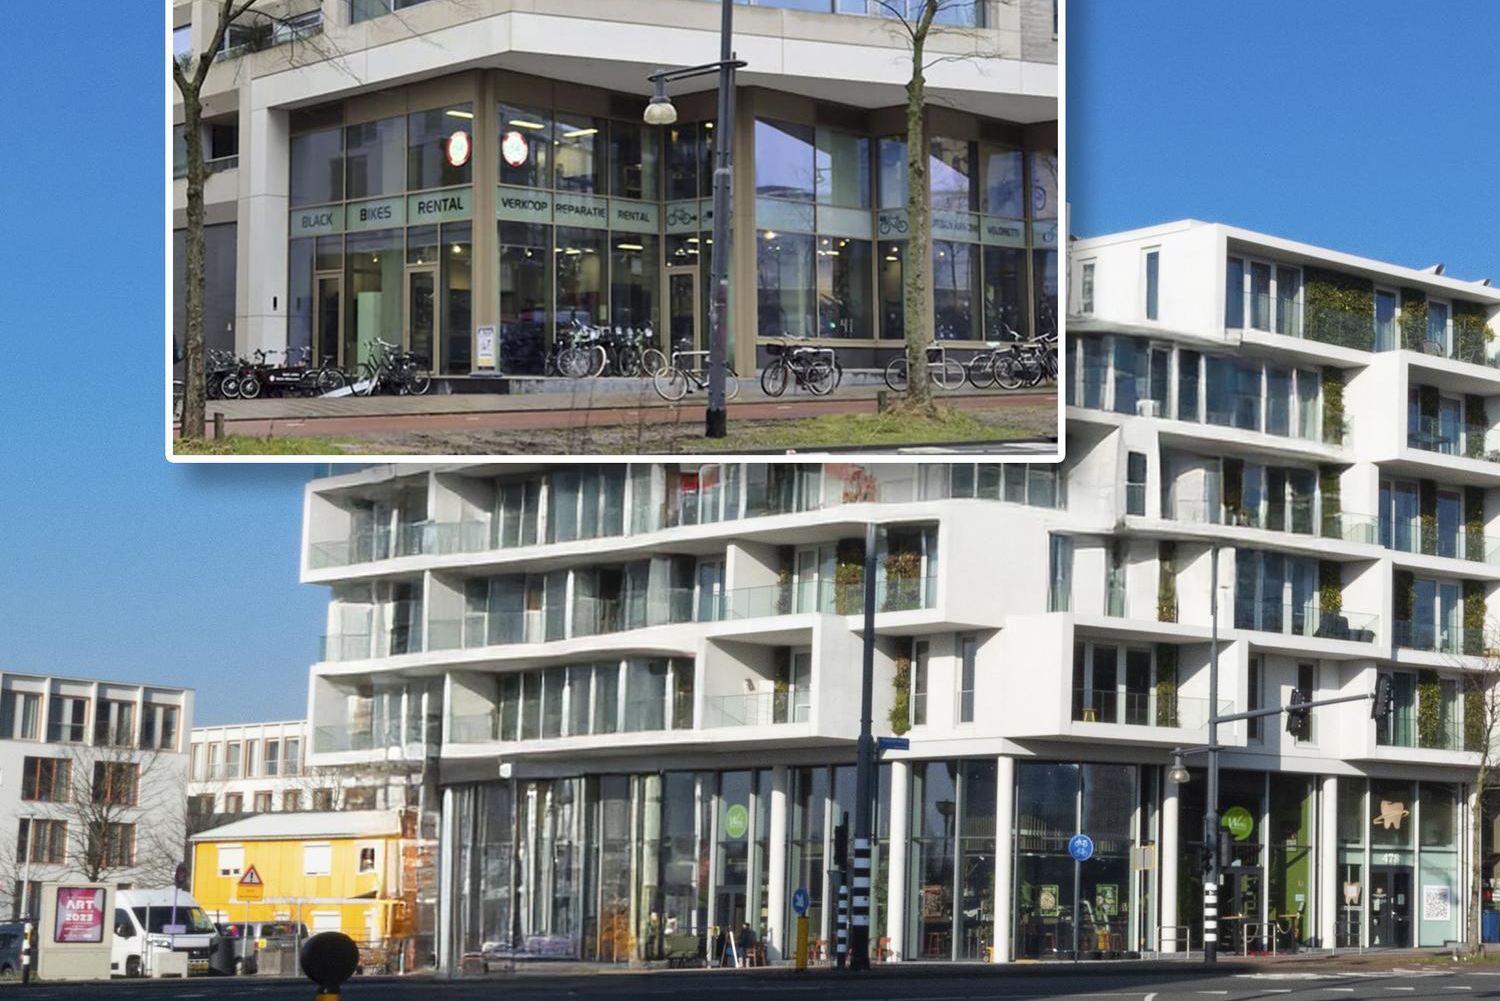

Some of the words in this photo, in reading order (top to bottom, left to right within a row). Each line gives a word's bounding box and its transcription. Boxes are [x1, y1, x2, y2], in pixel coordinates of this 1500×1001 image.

[301, 212, 334, 229] BLACK
[359, 205, 392, 222] BIKES
[417, 196, 464, 216] RENTAL
[501, 197, 548, 211] VERKOOP
[555, 203, 606, 219] REPARATIE
[617, 208, 650, 223] RENTAL
[66, 899, 94, 910] ART
